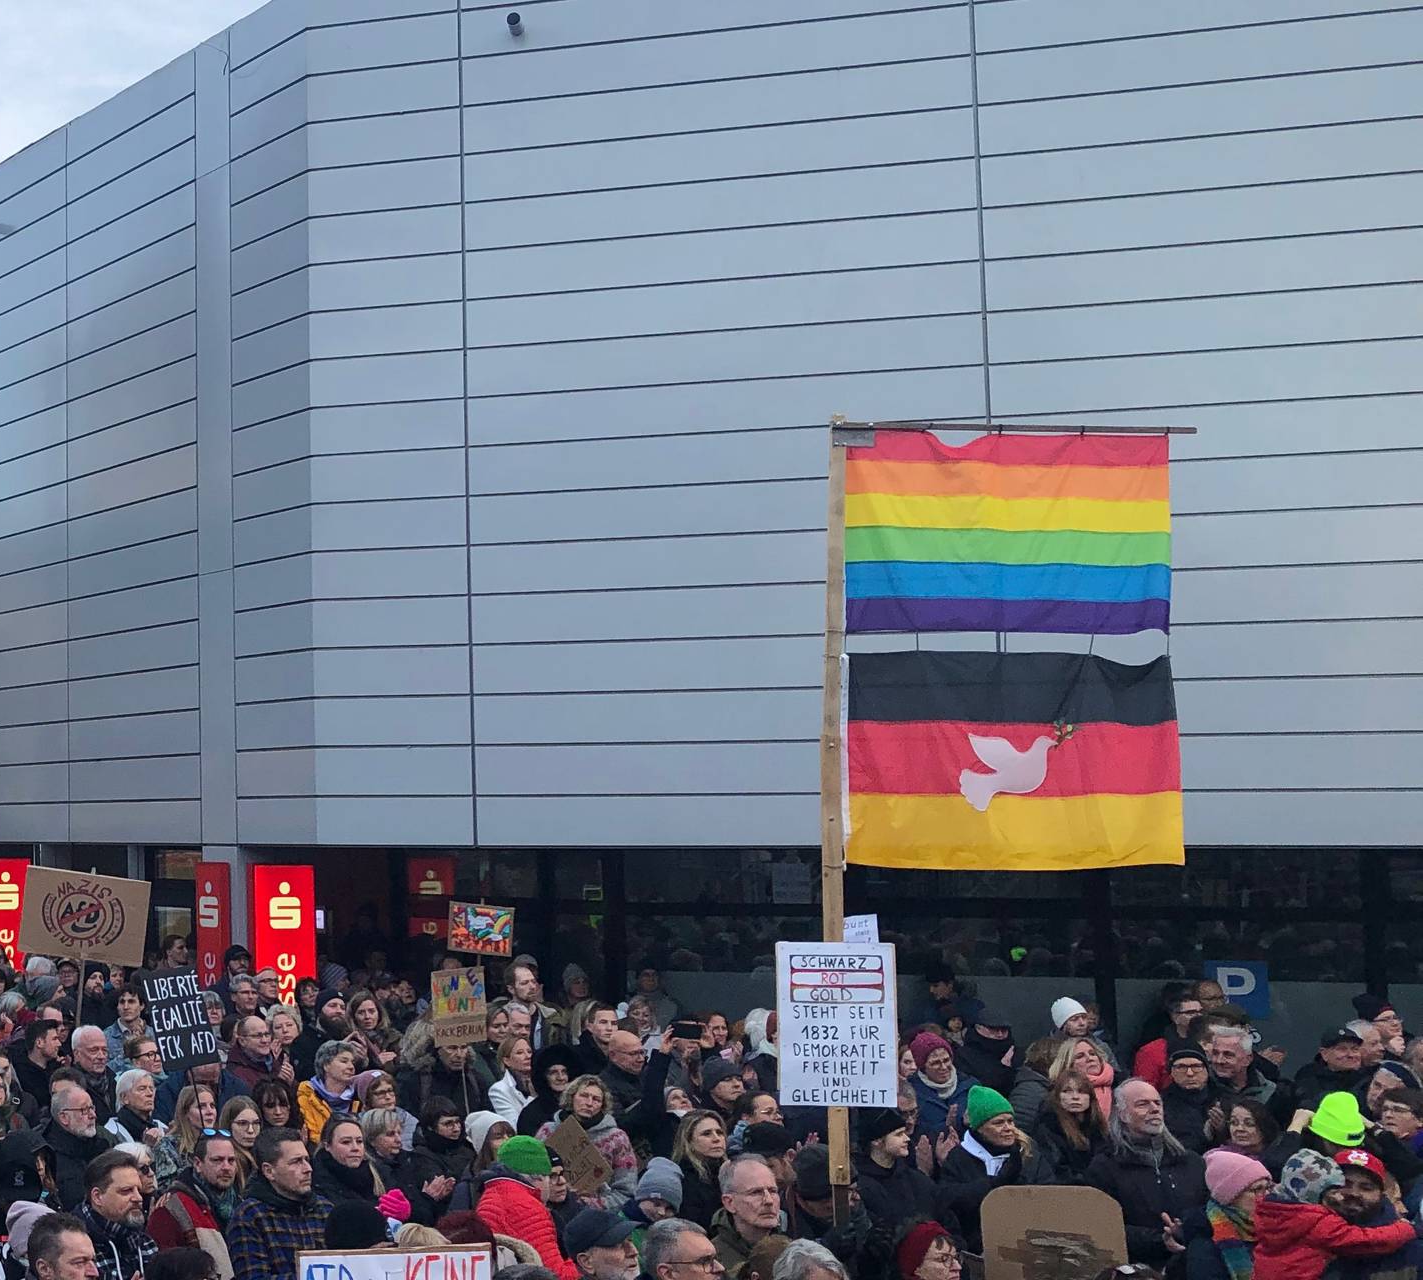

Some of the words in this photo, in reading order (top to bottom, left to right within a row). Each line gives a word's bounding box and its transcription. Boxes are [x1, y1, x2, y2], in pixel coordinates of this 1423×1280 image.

[57, 879, 113, 899] NAZIS
[800, 957, 867, 970] SCHWARZ
[143, 969, 203, 1001] LIBERTÉ
[821, 972, 848, 985] ROT
[810, 988, 853, 1001] GOLD
[152, 996, 207, 1032] ÉGALITÉ
[793, 1005, 838, 1019] STEHT
[849, 1006, 885, 1019] SEIT
[801, 1025, 839, 1040] 1832
[850, 1024, 880, 1041] FÜR
[158, 1035, 184, 1062] FCK
[191, 1031, 216, 1055] AFD
[792, 1043, 886, 1059] DEMOKRATIE
[802, 1061, 879, 1076] FREIHEIT
[822, 1077, 851, 1088] UND
[792, 1089, 888, 1104] GLEICHHEIT
